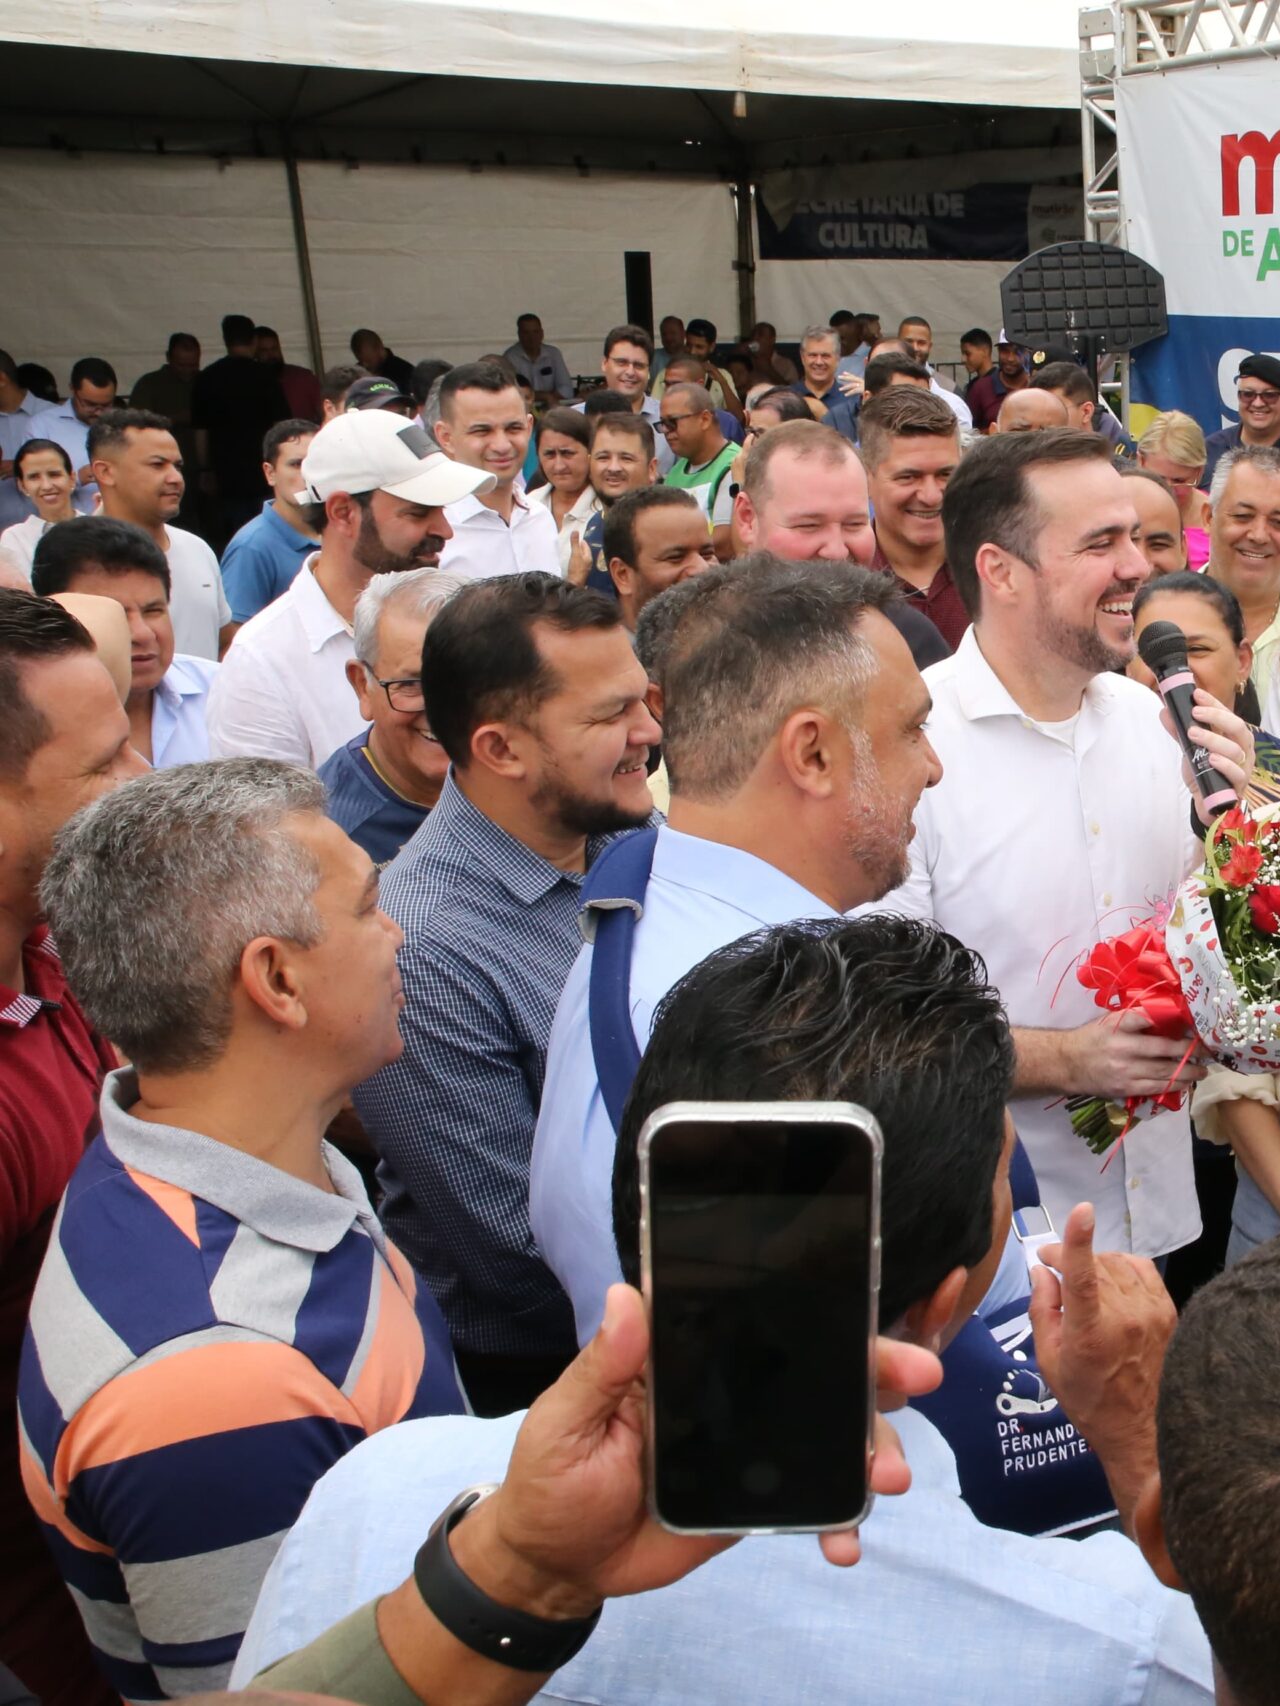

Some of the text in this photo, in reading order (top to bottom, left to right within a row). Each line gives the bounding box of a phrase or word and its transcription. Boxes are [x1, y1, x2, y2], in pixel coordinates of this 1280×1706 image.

[934, 193, 965, 218] DE
[818, 222, 928, 249] CULTURA
[1222, 229, 1255, 258] DE
[1001, 1423, 1080, 1456] FERNAND
